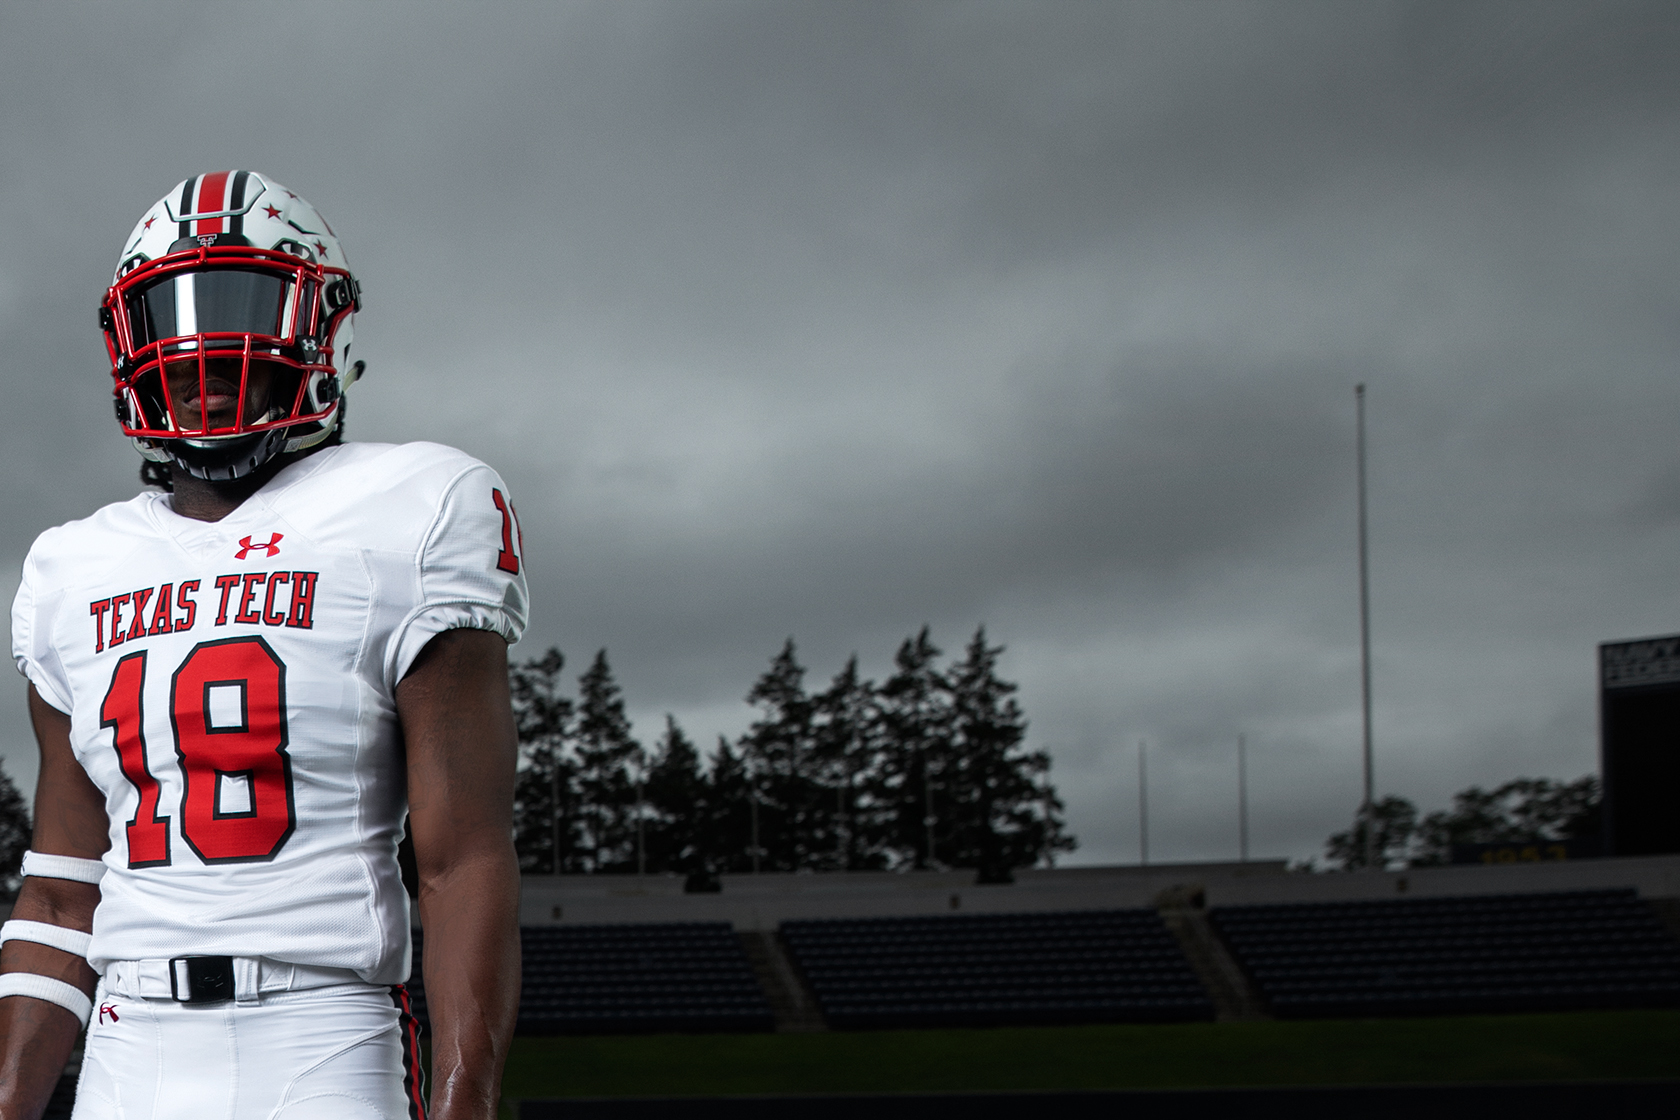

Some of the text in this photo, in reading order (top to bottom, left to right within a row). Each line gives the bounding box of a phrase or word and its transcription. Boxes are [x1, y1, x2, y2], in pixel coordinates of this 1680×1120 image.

[89, 570, 320, 655] TEXAS TECH
[99, 634, 297, 870] 18
